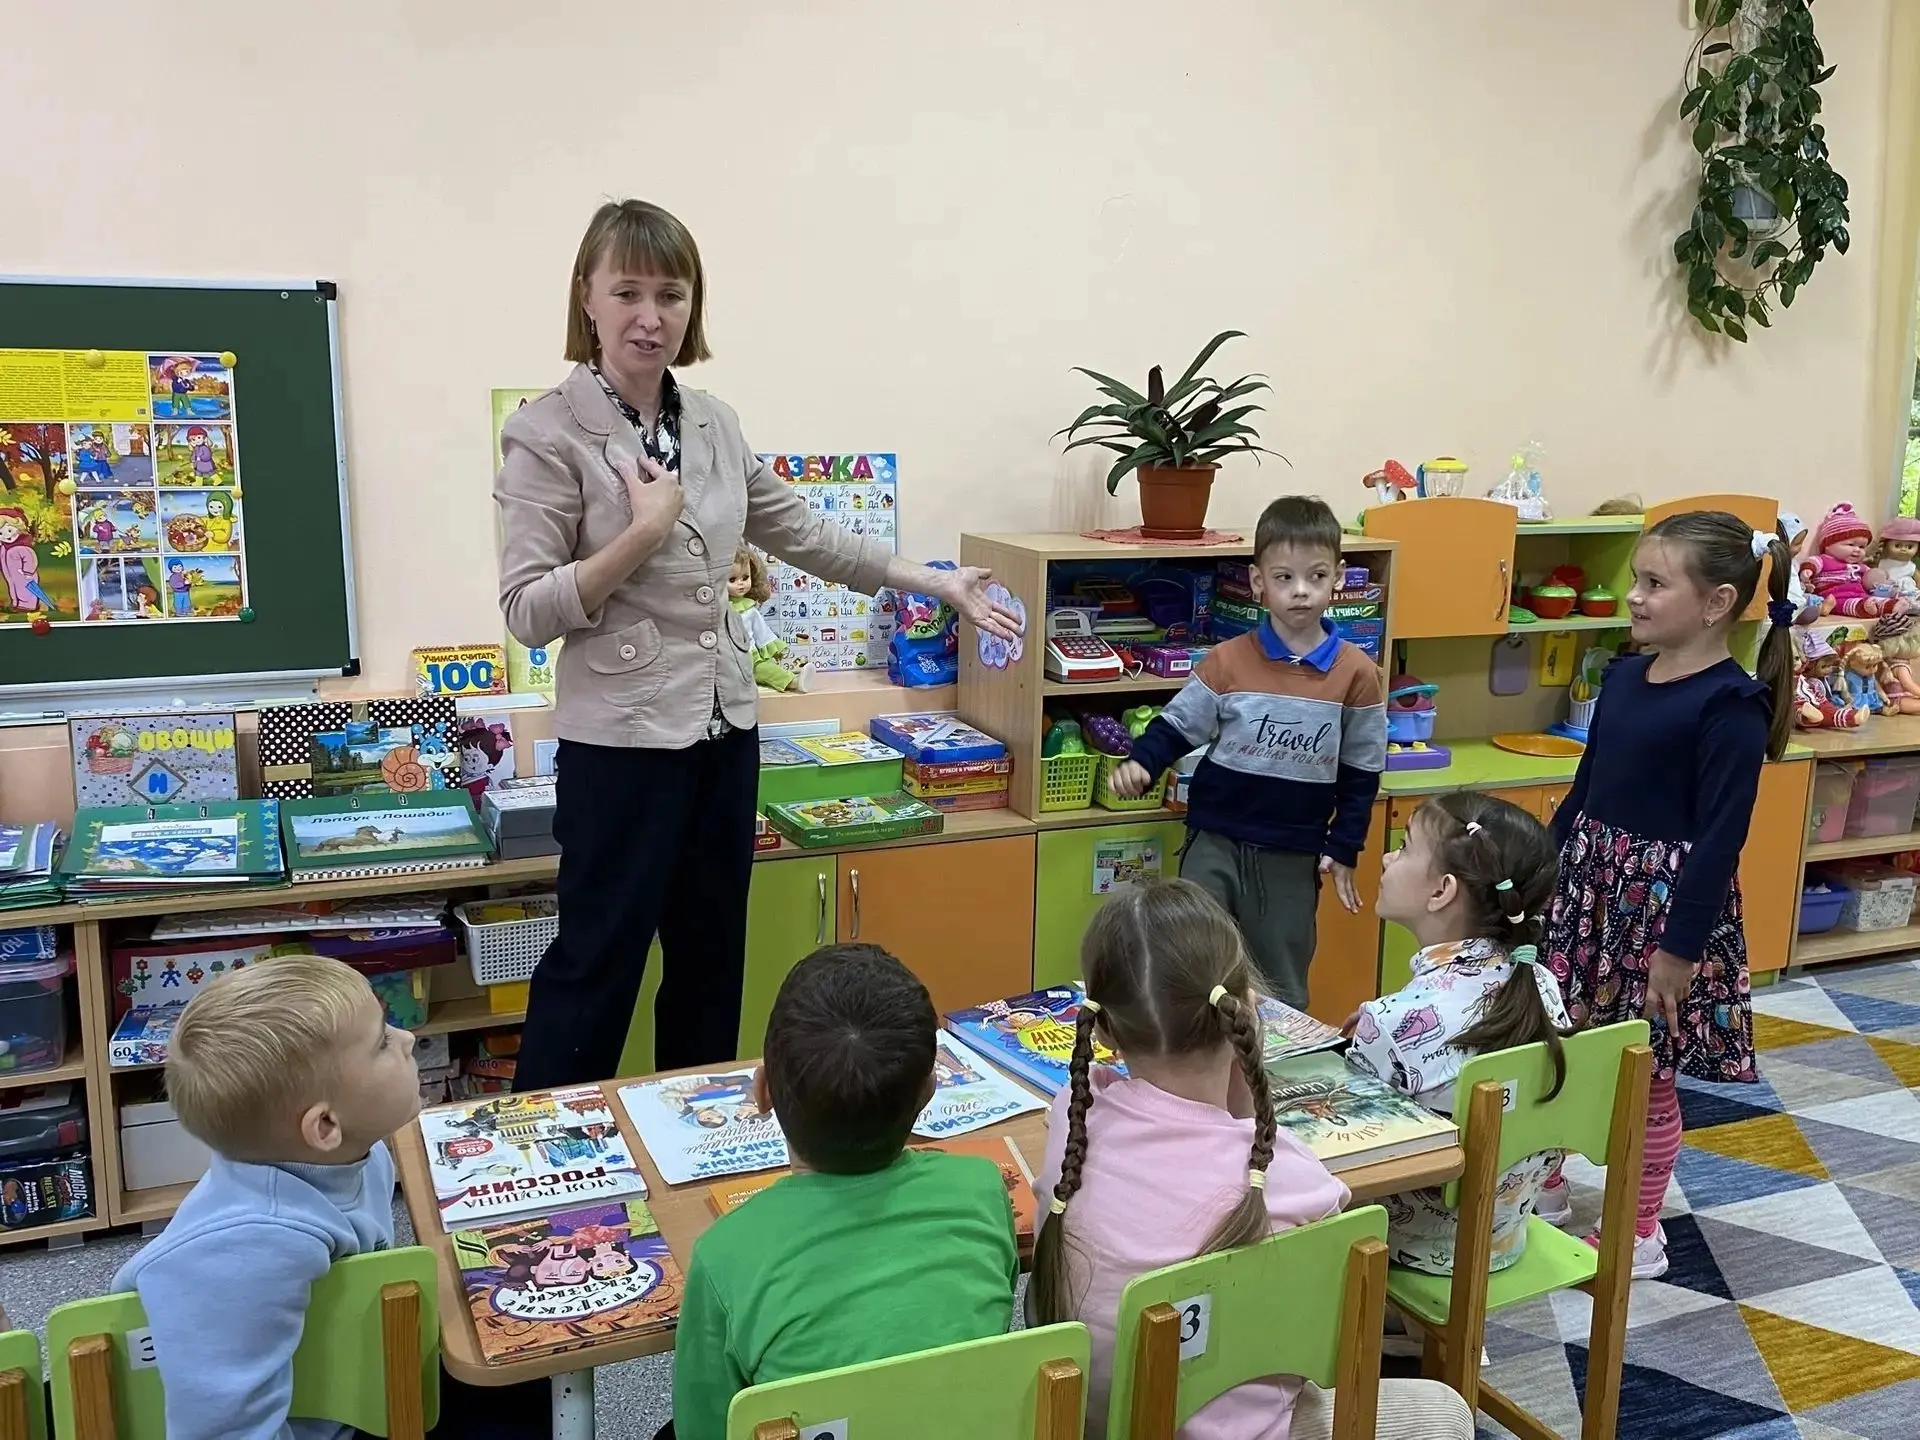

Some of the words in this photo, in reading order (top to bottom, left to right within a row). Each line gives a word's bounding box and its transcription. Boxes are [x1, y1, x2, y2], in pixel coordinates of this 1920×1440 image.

[772, 455, 874, 482] АЗБУКА
[809, 501, 820, 509] Вв
[838, 501, 848, 509] Гг
[781, 583, 793, 591] Пп
[810, 582, 822, 592] Рр
[781, 610, 797, 618] Фф
[422, 653, 459, 664] УЧИМСЯ
[460, 652, 497, 661] СЧИТАТЬ
[426, 660, 494, 693] 100
[137, 727, 235, 756] ОВОЩИ
[1249, 713, 1332, 754] travel
[311, 814, 371, 824] Лэпбук
[374, 810, 453, 820] «Лошади»
[113, 1046, 132, 1058] 60
[926, 1101, 1022, 1133] РОССИЯ
[690, 1158, 785, 1178] ОВОРИМ
[695, 1149, 786, 1170] РАЗНЫХ
[68, 1168, 88, 1200] MAGIC
[468, 1165, 608, 1197] РОССИЯ
[567, 1176, 618, 1195] МОЯ
[31, 1181, 40, 1211] Amazing
[463, 1188, 561, 1208] РОДИНА
[1179, 1302, 1202, 1345] 3
